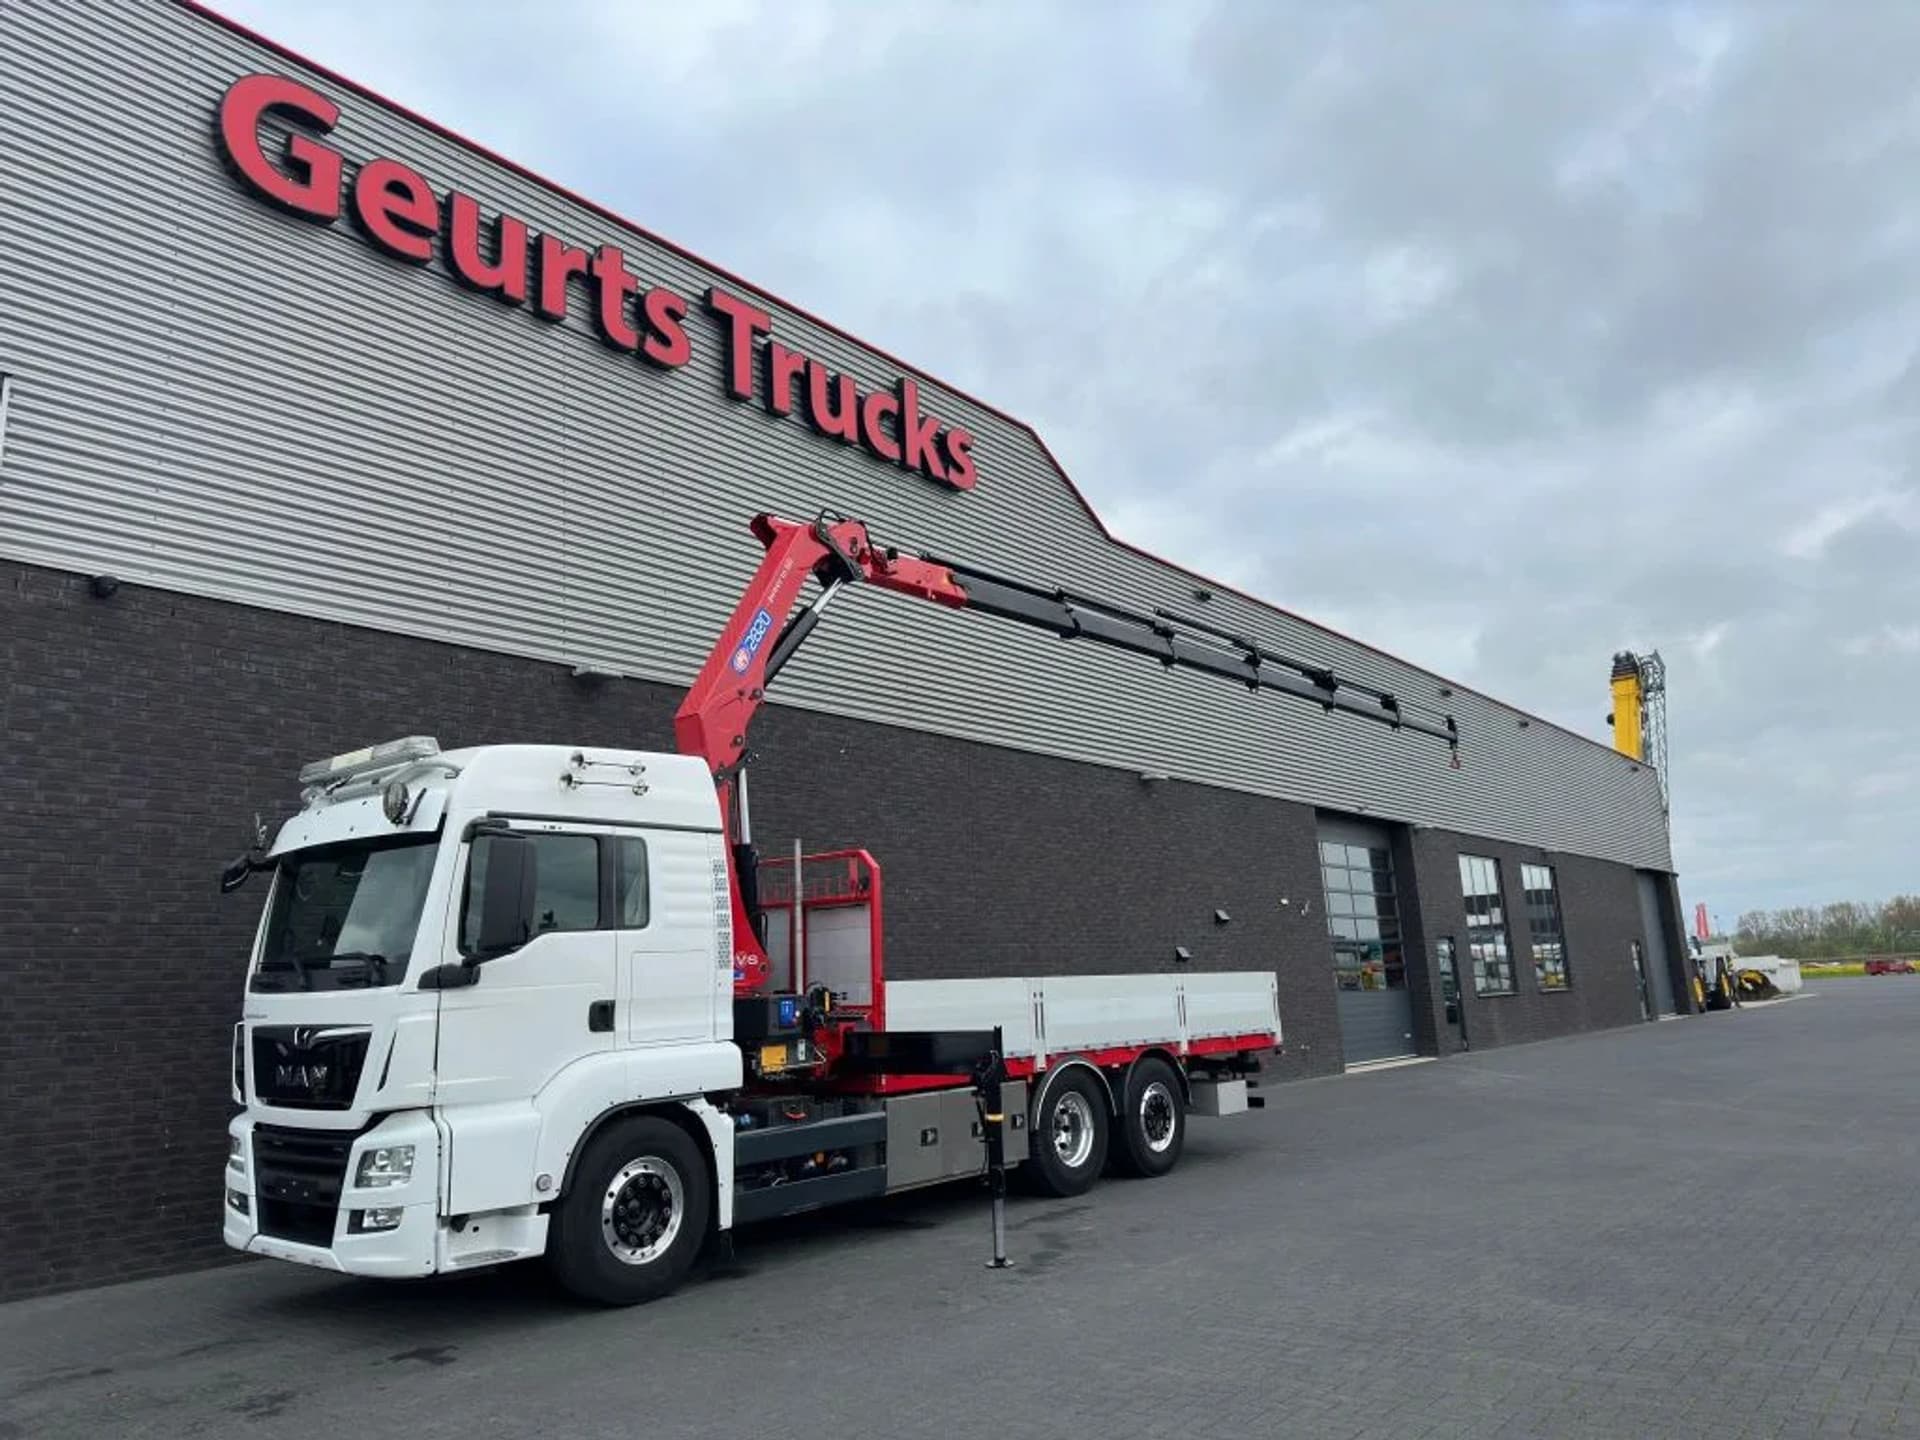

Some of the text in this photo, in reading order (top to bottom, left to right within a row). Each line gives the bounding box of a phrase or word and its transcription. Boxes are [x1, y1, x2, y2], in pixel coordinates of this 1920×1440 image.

[219, 73, 978, 491] Geurts Trucks
[276, 1065, 328, 1089] MAN
